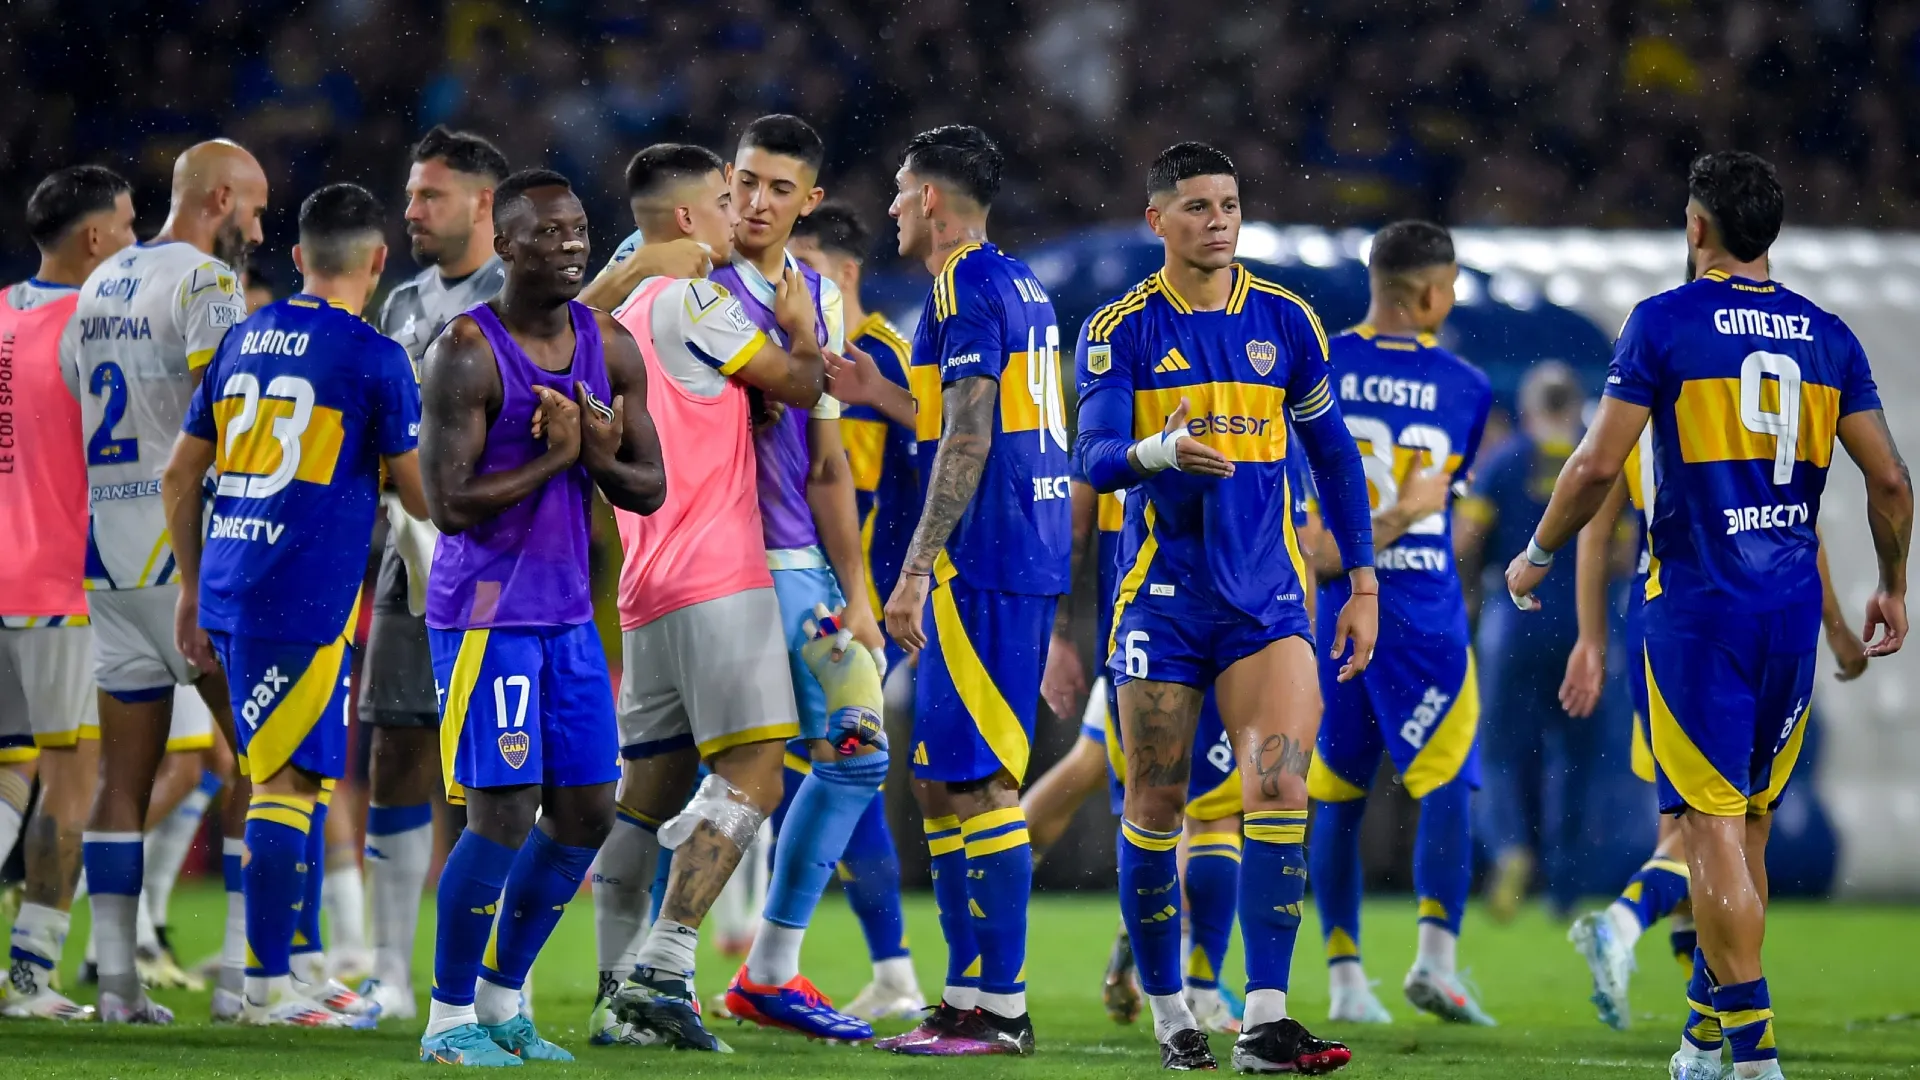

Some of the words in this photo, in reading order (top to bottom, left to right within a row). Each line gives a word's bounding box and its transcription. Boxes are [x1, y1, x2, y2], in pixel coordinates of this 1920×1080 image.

[96, 275, 142, 303] kanji
[240, 329, 310, 357] BLANCO
[1713, 308, 1814, 342] GIMENEZ
[948, 353, 981, 367] ROGAR
[1340, 372, 1437, 411] A.COSTA
[87, 361, 139, 466] 2
[1740, 350, 1801, 485] 9
[216, 373, 315, 499] 23
[210, 514, 285, 545] DIRECTV
[1723, 502, 1809, 535] DIRECTV
[1374, 546, 1448, 573] RECTV
[1125, 630, 1150, 679] 6
[241, 665, 289, 730] pax
[493, 675, 531, 728] 17
[1400, 686, 1449, 749] pax
[503, 743, 526, 753] CABJ
